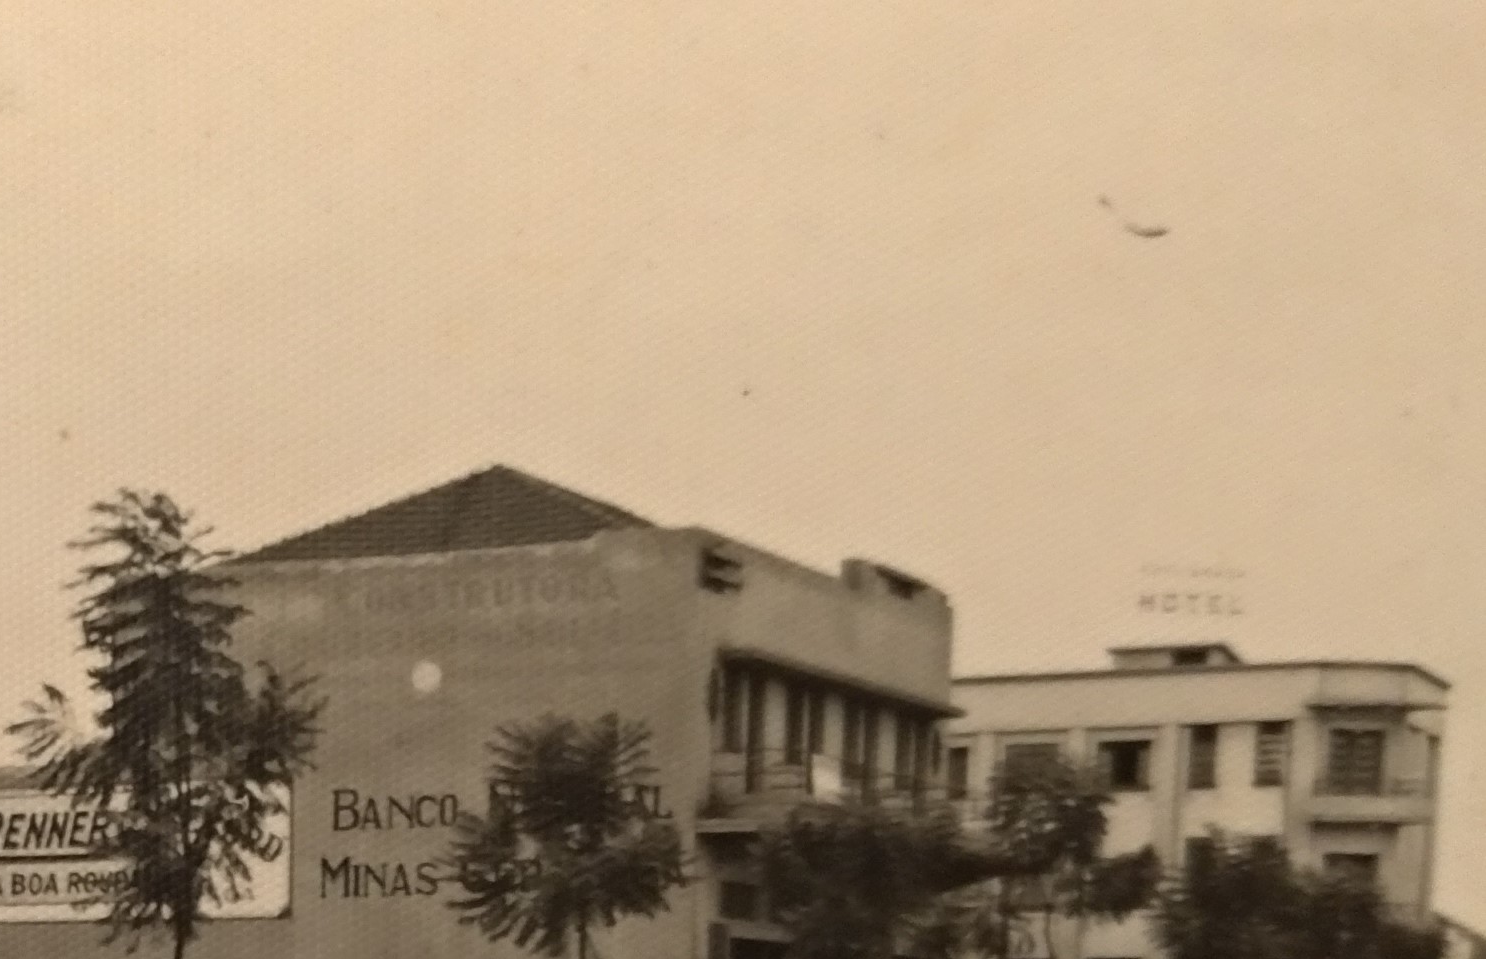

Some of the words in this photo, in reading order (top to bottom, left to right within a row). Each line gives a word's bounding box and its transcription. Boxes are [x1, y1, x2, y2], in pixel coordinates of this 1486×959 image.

[1138, 593, 1245, 615] HOTEL
[332, 788, 458, 831] BANCO
[10, 872, 59, 896] BOA
[320, 856, 439, 898] MINAS
